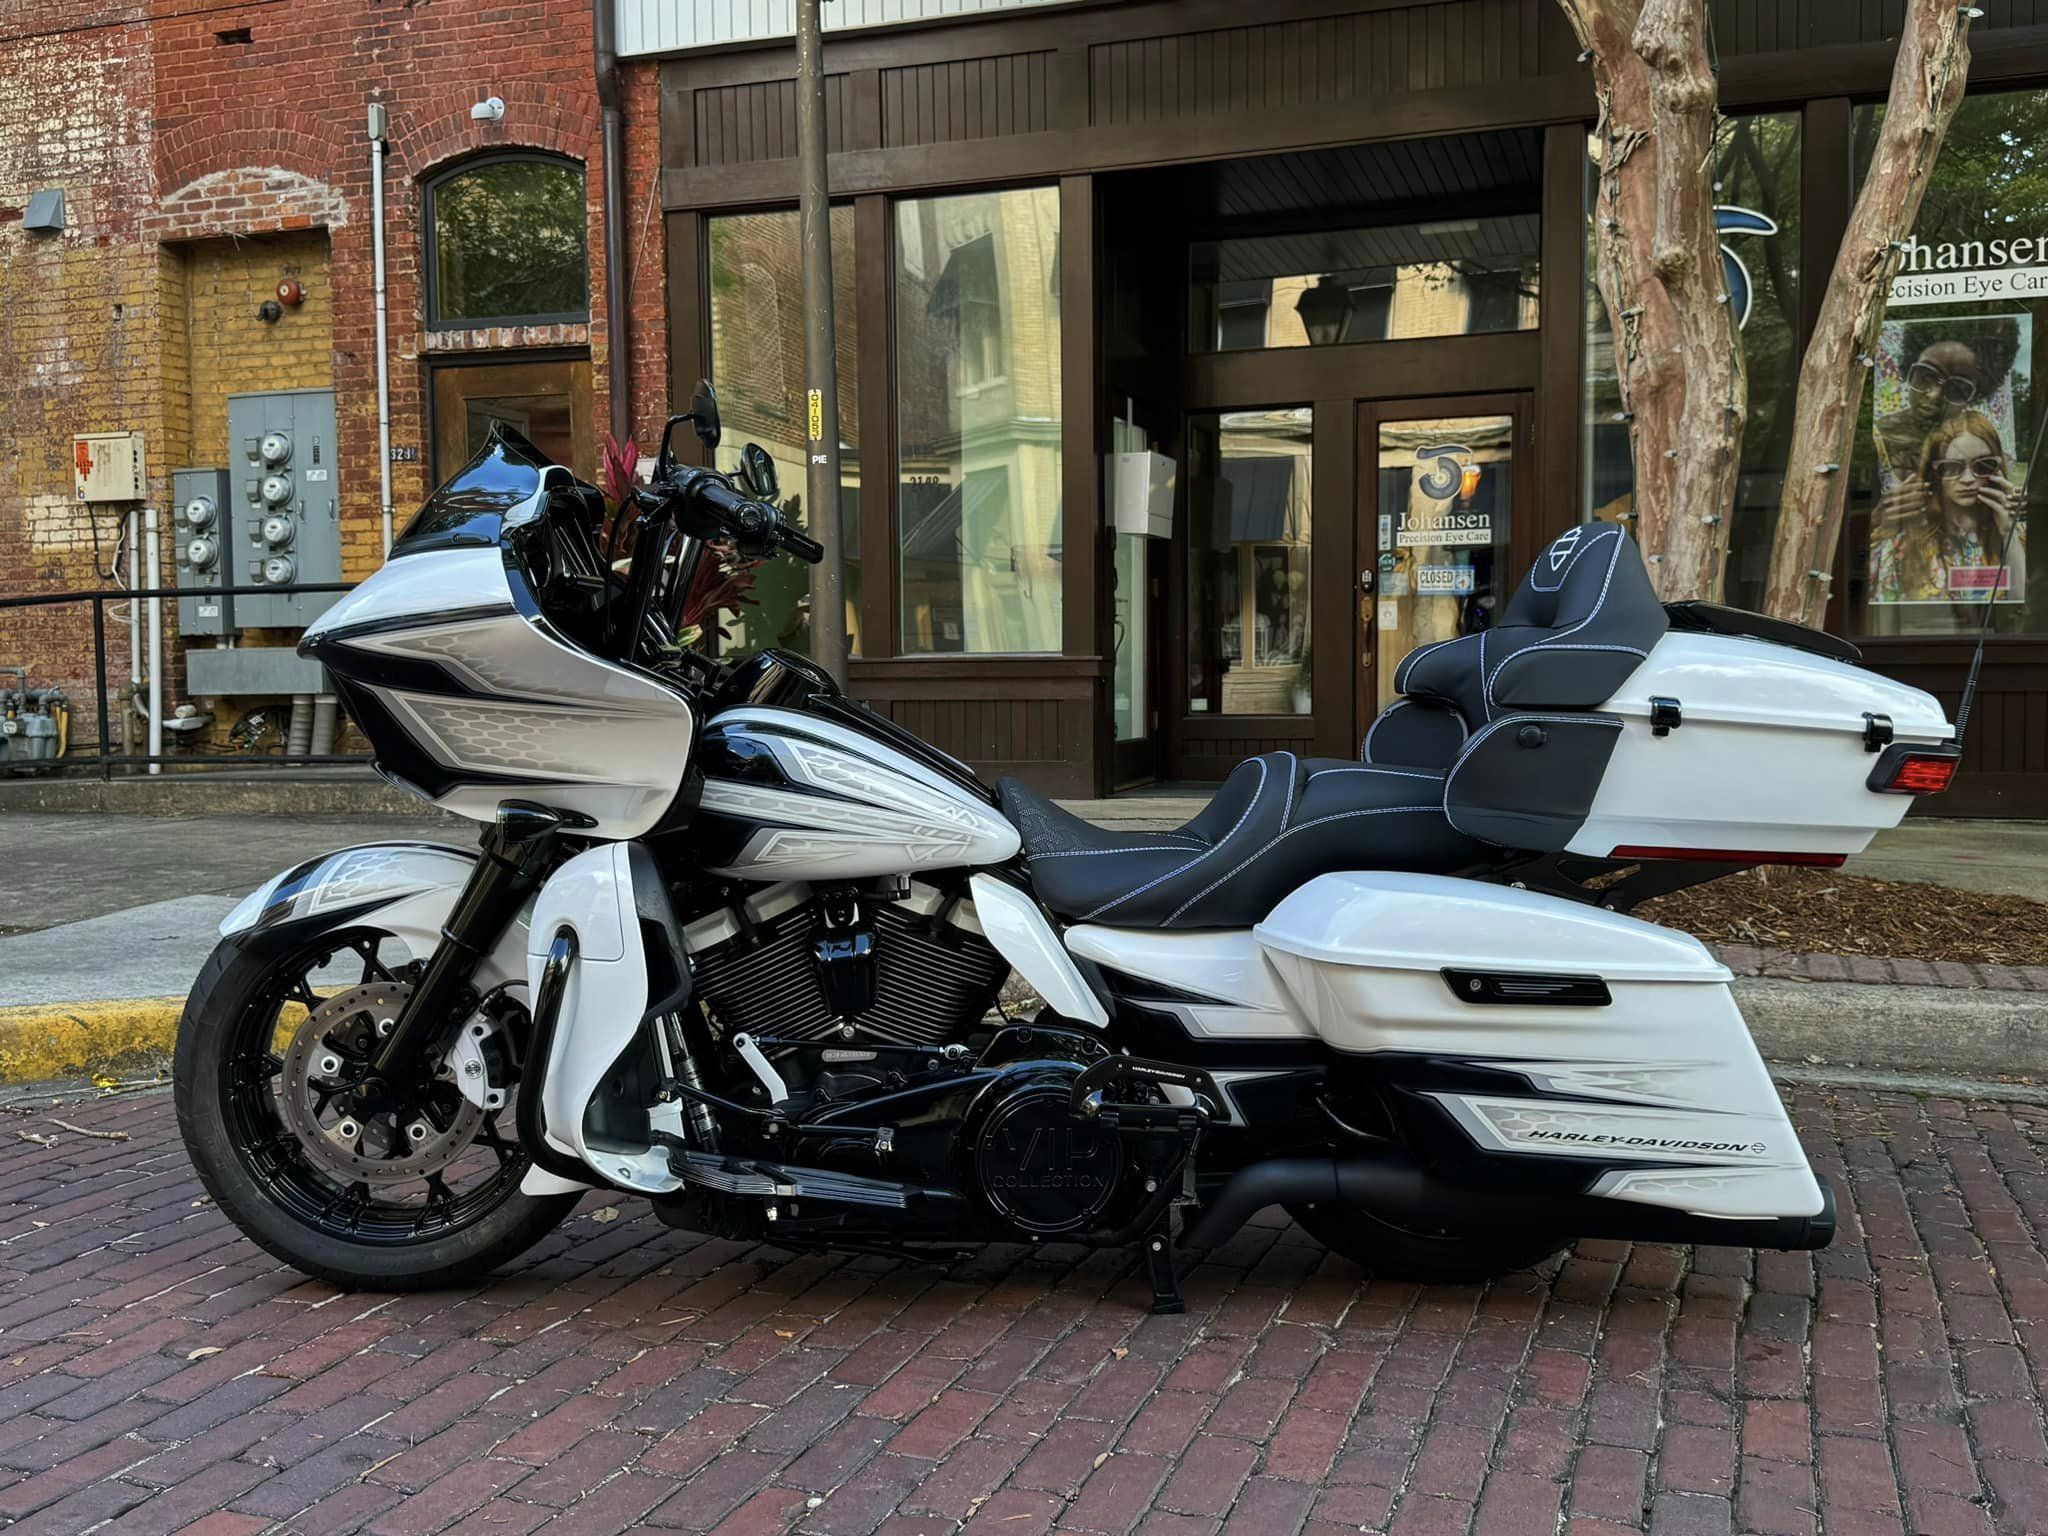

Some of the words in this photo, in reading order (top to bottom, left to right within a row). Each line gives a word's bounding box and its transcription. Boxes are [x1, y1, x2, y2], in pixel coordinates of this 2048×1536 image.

[1898, 235, 2048, 272] hanse
[1964, 275, 2003, 297] Eye
[2010, 272, 2048, 291] Car
[811, 454, 828, 464] PIE
[1397, 512, 1490, 531] Johansen
[1399, 533, 1442, 544] Precision
[1445, 532, 1464, 543] Eye
[1466, 531, 1489, 541] Care
[1419, 571, 1453, 585] CLOSED
[1002, 1127, 1099, 1171] VIP
[1528, 1130, 1749, 1152] HARLEY-DAVIDSON
[993, 1175, 1106, 1188] COLLECTION
